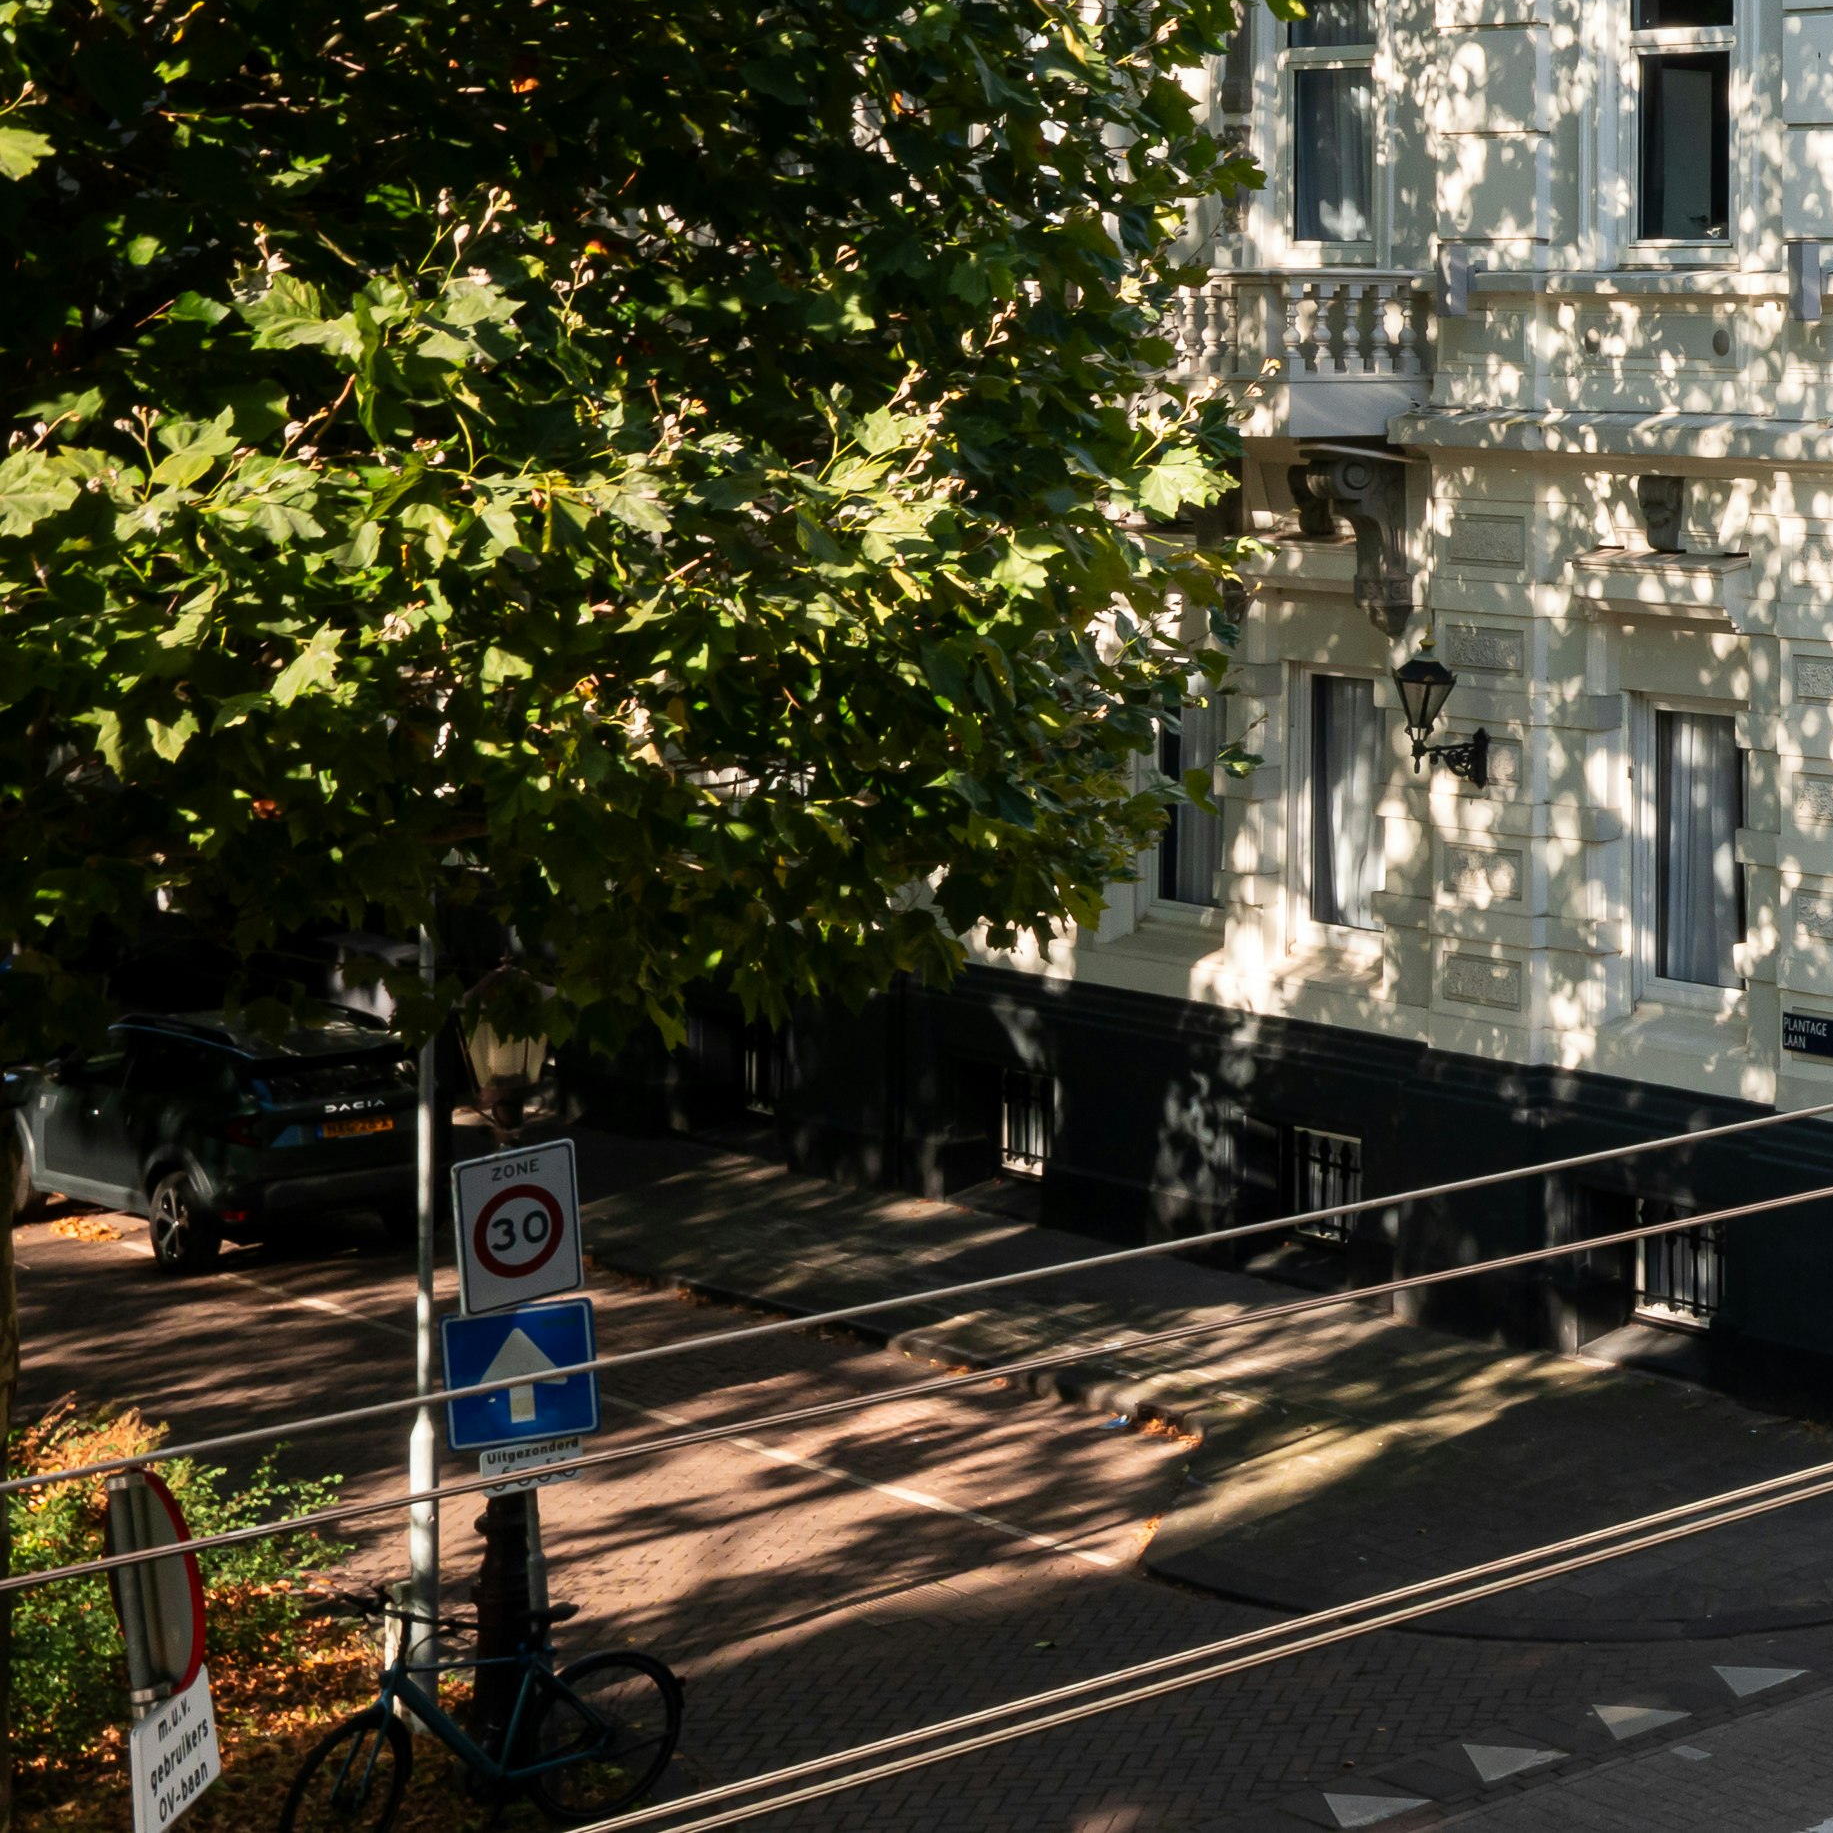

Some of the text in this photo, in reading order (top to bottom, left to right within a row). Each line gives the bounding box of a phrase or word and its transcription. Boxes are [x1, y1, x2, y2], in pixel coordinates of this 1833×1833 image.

[1783, 1017, 1827, 1037] PLANTAGE
[1783, 1033, 1806, 1049] LAAN
[325, 1099, 385, 1113] DACIA
[491, 1158, 540, 1182] ZONE
[491, 1210, 549, 1252] 30
[487, 1437, 579, 1464] Uitgezonderd
[158, 1697, 191, 1742] m.u.v.
[151, 1718, 209, 1797] gebruikers
[159, 1761, 209, 1823] OV-baan
